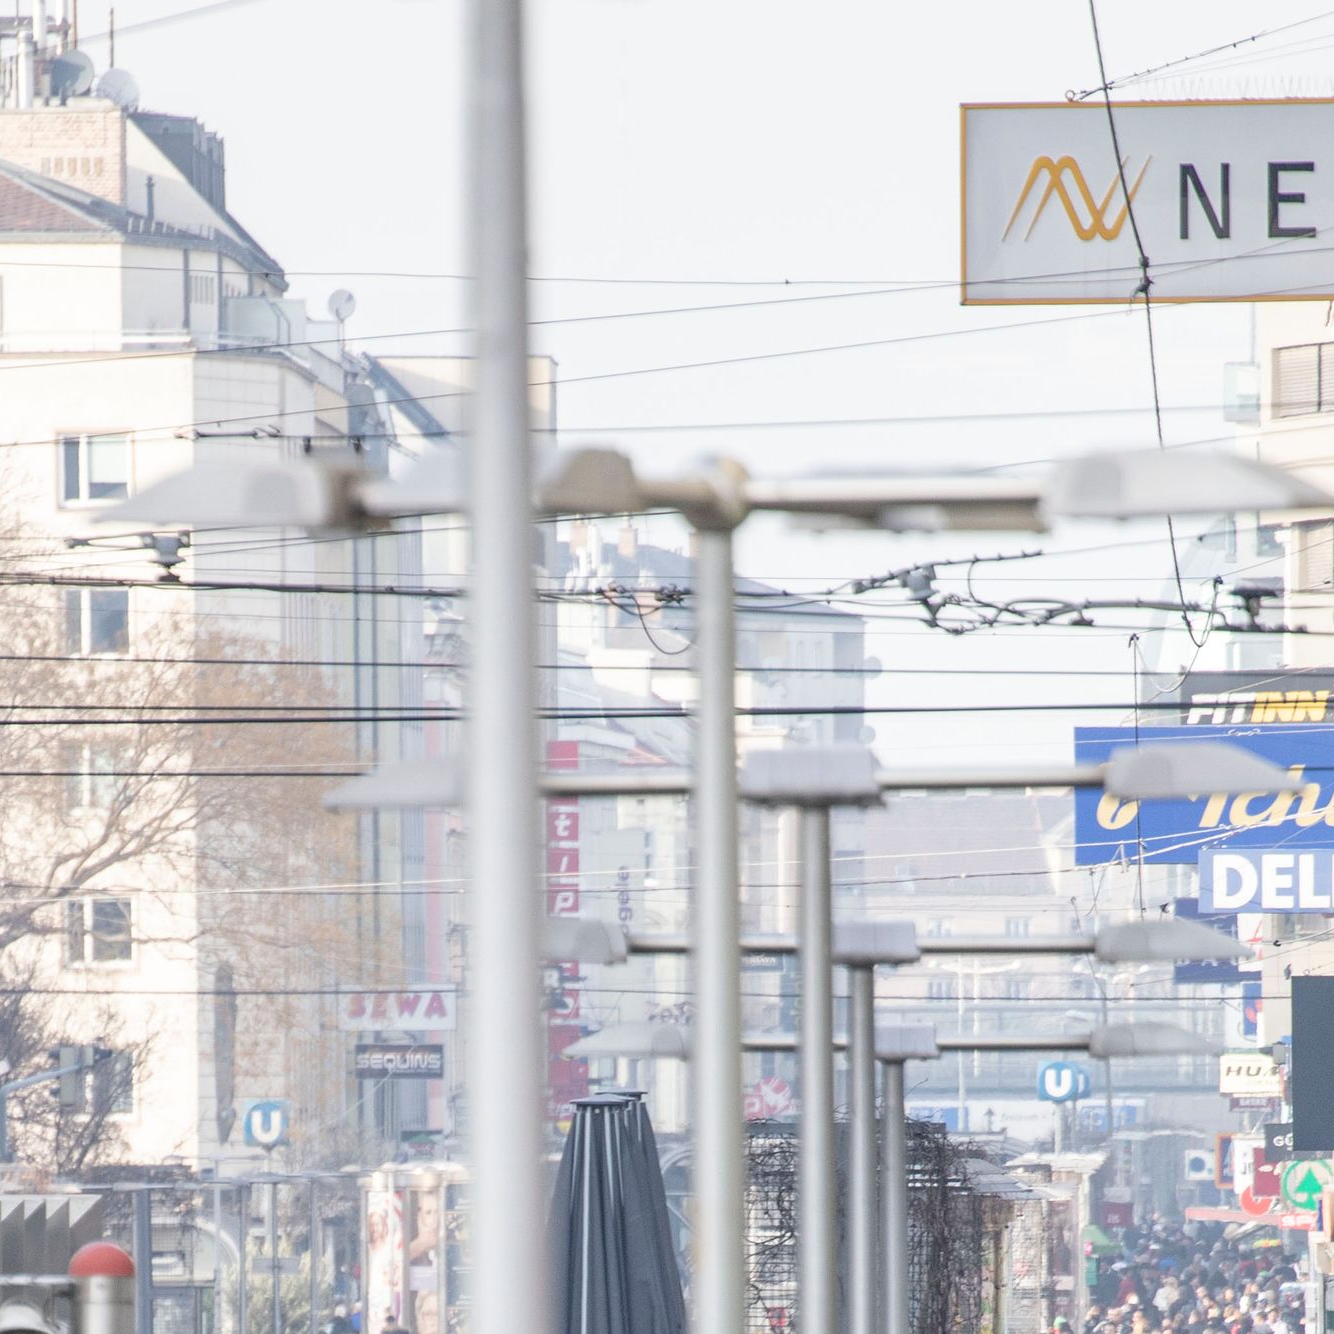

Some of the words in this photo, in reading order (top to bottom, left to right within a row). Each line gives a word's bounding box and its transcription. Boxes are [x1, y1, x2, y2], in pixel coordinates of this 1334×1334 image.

[356, 1053, 441, 1070] SEQUINS
[1044, 1068, 1072, 1098] U
[251, 1110, 282, 1143] U
